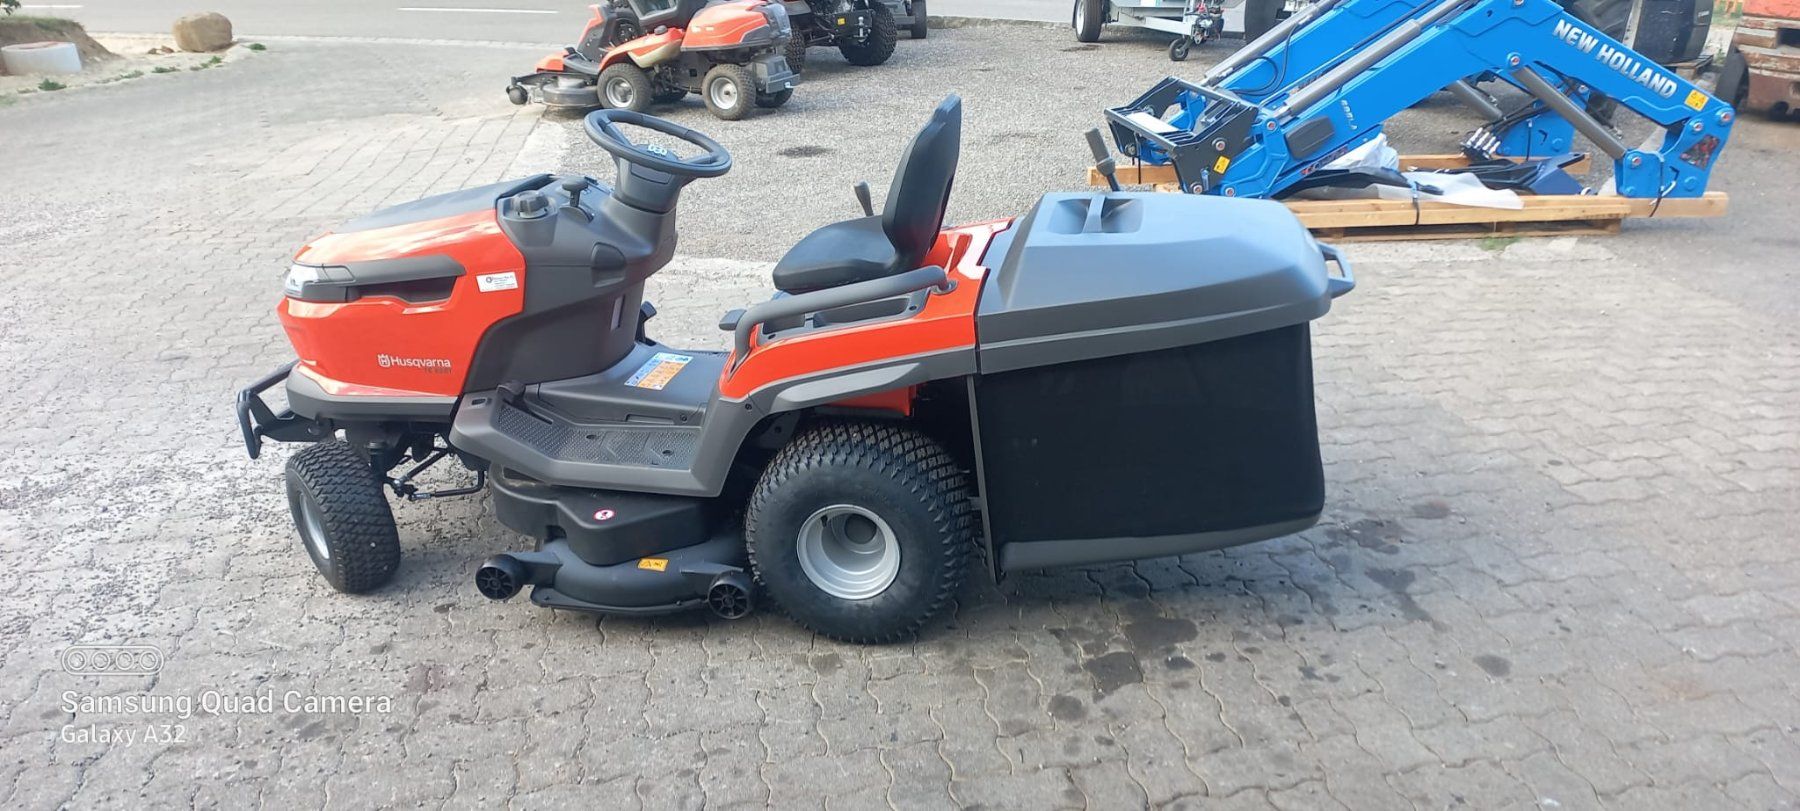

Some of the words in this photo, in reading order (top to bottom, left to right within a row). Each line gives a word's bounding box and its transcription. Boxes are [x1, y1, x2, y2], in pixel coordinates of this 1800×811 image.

[1553, 19, 1599, 54] NEW
[1596, 43, 1678, 99] HOLLAND
[390, 356, 451, 368] Husqvarna
